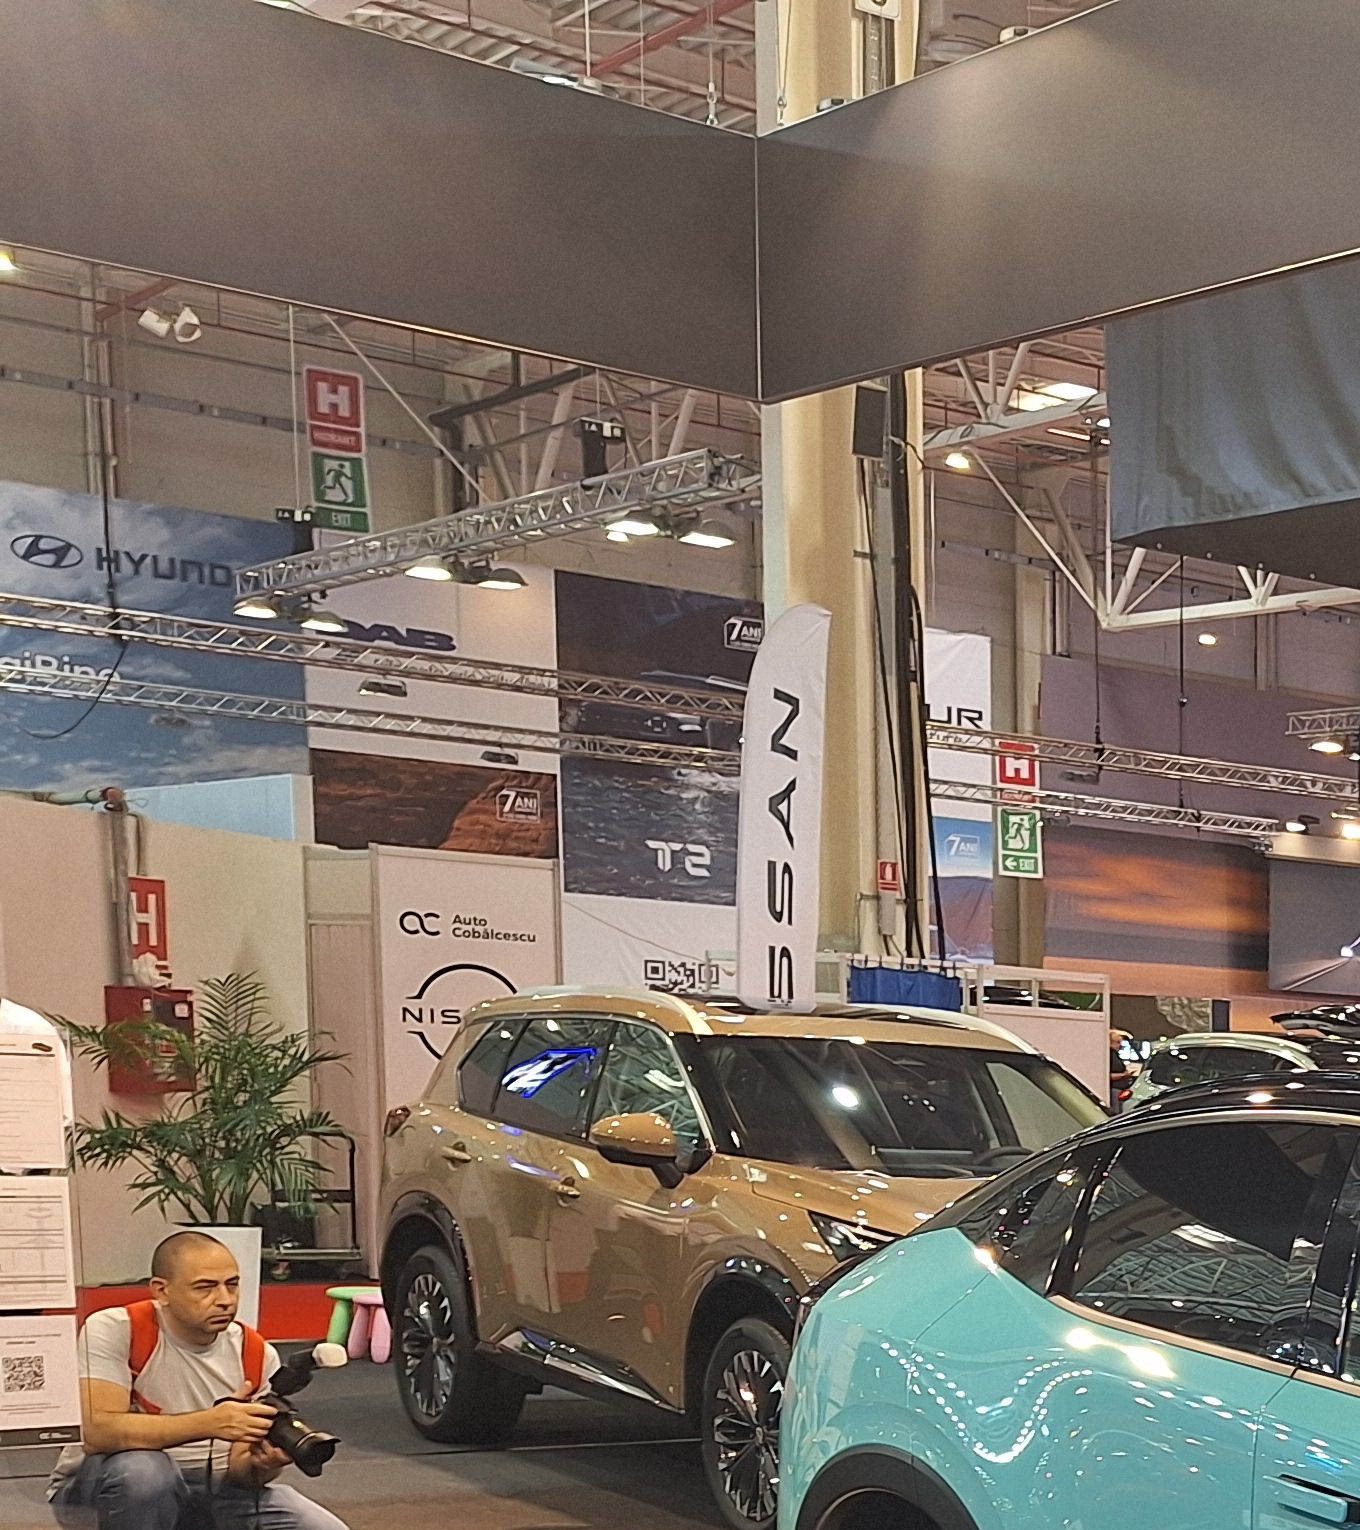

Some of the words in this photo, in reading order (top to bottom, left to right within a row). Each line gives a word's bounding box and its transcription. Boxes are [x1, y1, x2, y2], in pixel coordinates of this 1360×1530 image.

[317, 381, 350, 418] H
[96, 547, 235, 587] HYUND
[452, 914, 488, 927] Auto
[451, 926, 537, 943] Cobălcescu
[402, 1006, 462, 1026] NIS
